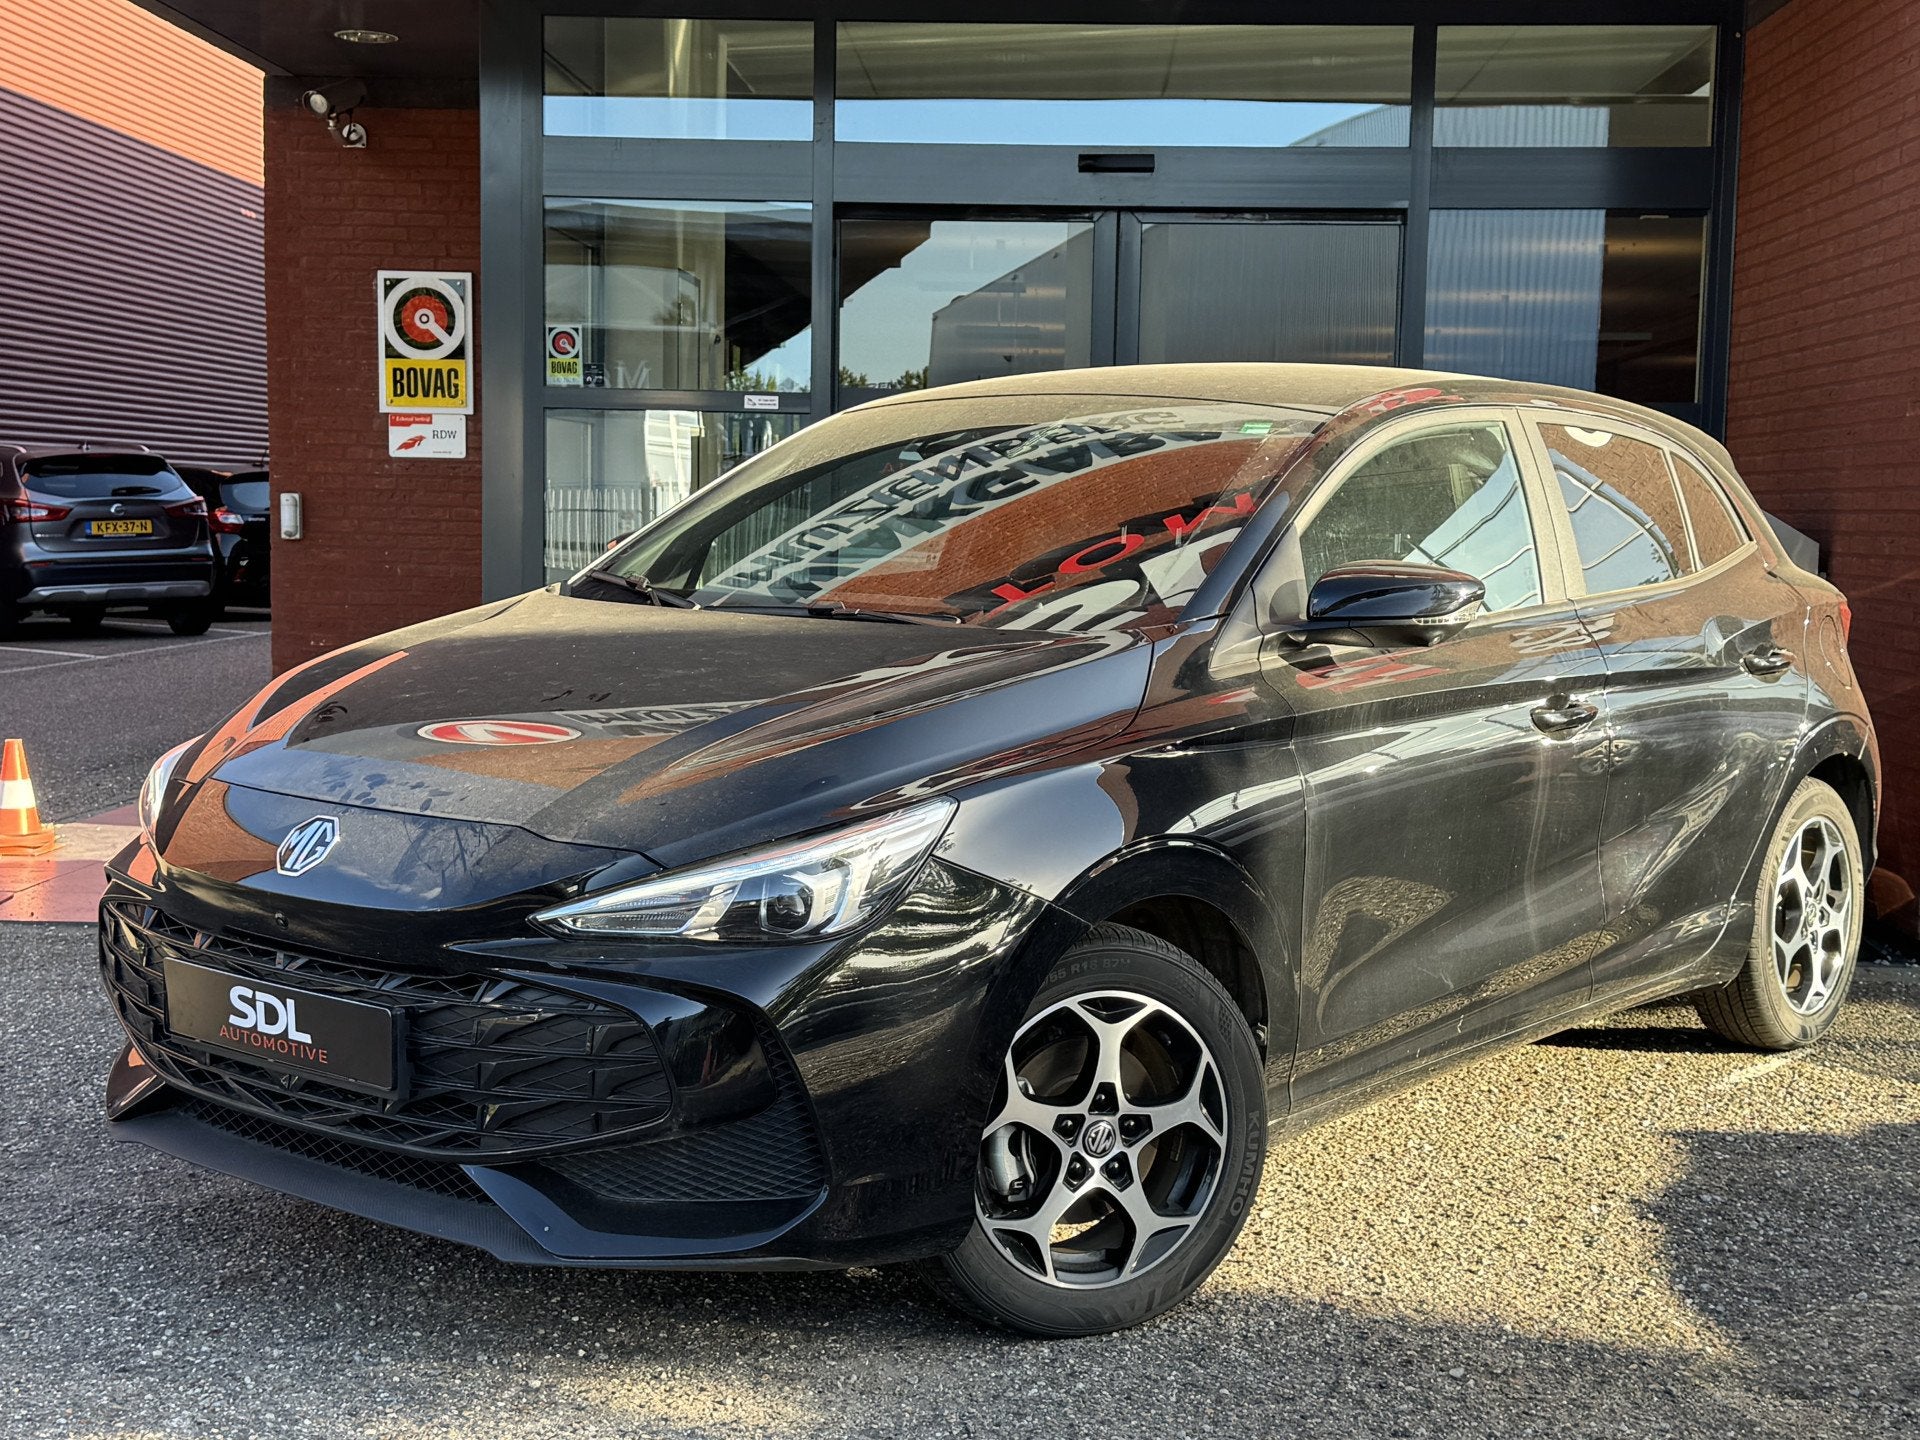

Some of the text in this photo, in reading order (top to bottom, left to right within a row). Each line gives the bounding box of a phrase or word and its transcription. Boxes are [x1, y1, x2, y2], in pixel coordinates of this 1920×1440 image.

[392, 367, 460, 399] BOVAG
[551, 361, 578, 374] BOVAG
[432, 429, 457, 439] RDW
[97, 521, 148, 533] KFX-37-N
[282, 820, 333, 871] MG
[229, 986, 312, 1044] SDL
[219, 1024, 328, 1064] AUTOMOTIVE
[1230, 1110, 1260, 1217] KUMHO
